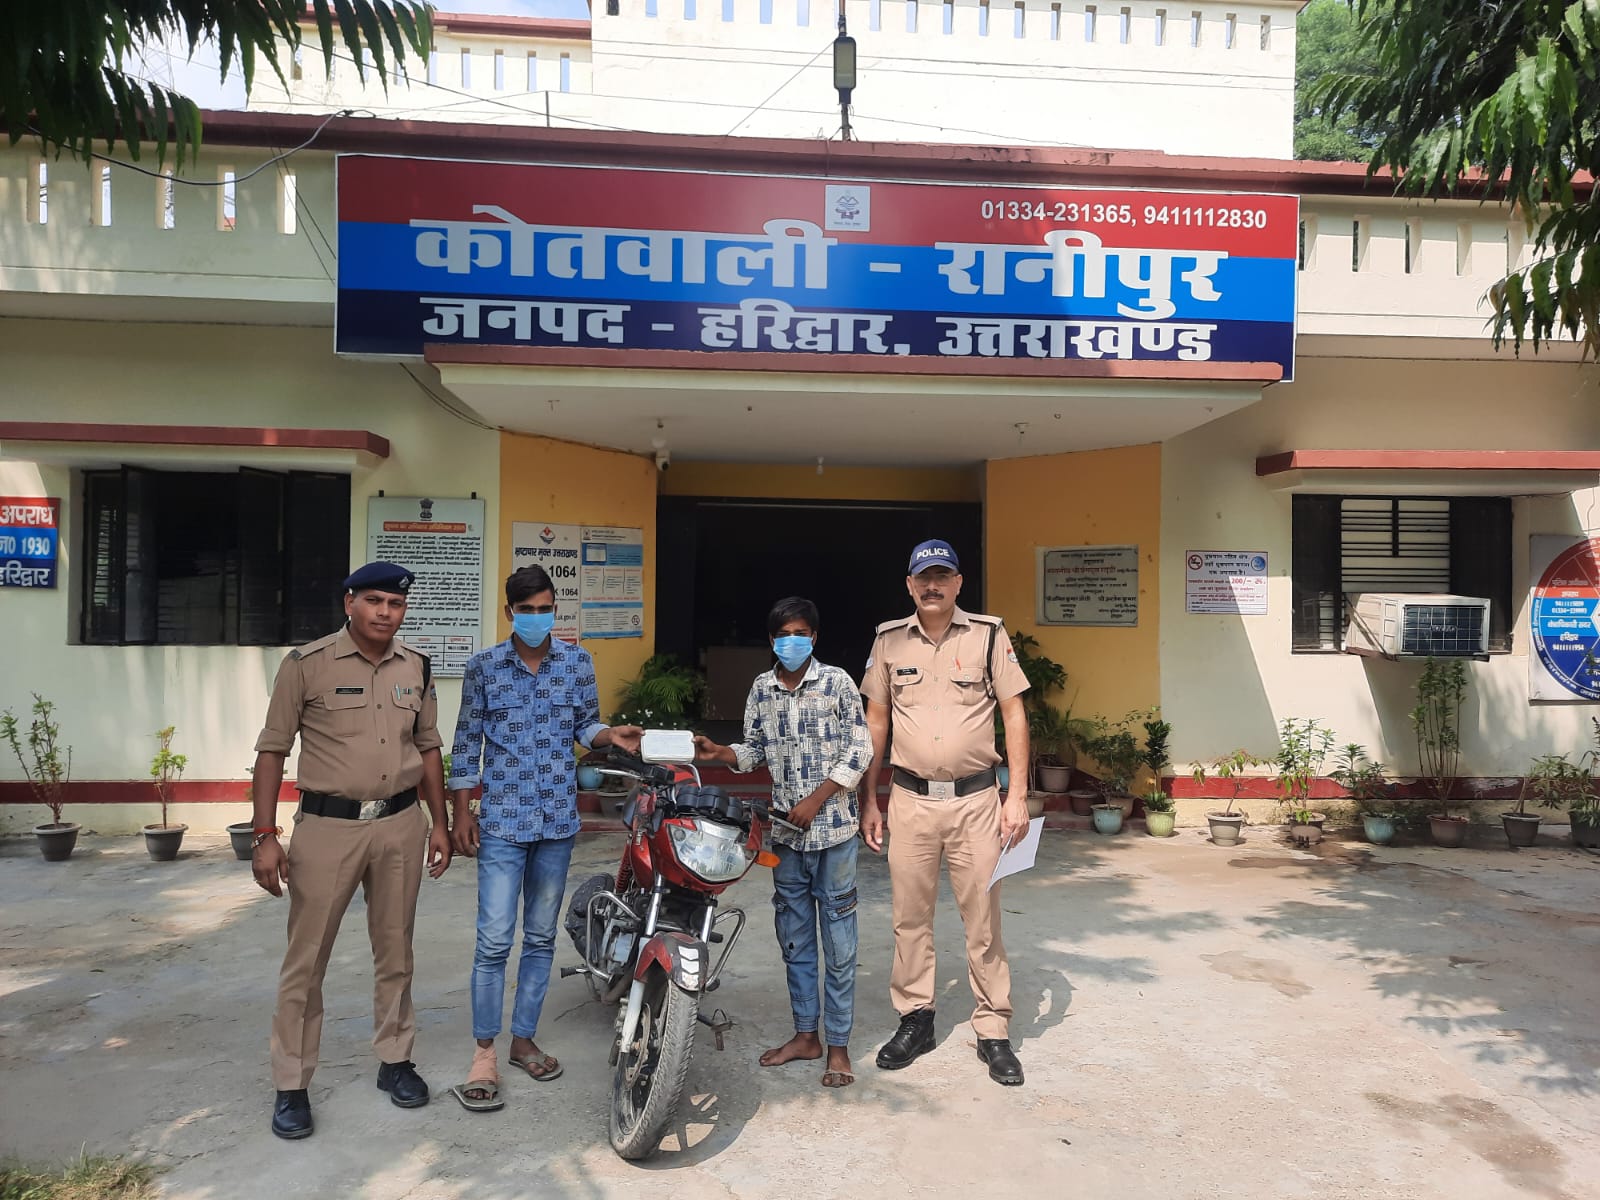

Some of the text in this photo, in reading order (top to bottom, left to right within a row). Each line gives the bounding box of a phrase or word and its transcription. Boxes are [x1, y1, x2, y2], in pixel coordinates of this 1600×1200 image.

[981, 200, 1267, 229] 01334-231365, 9411112830
[409, 204, 838, 289] कोतवाली
[935, 230, 1229, 320] रानीपुर
[420, 297, 631, 343] जनपद
[936, 316, 1217, 361] उत्तराखण्ड
[0, 505, 54, 525] अपराध
[21, 537, 50, 555] 1930
[917, 547, 949, 560] POLICE
[549, 565, 577, 578] 1064
[561, 588, 578, 597] 1064
